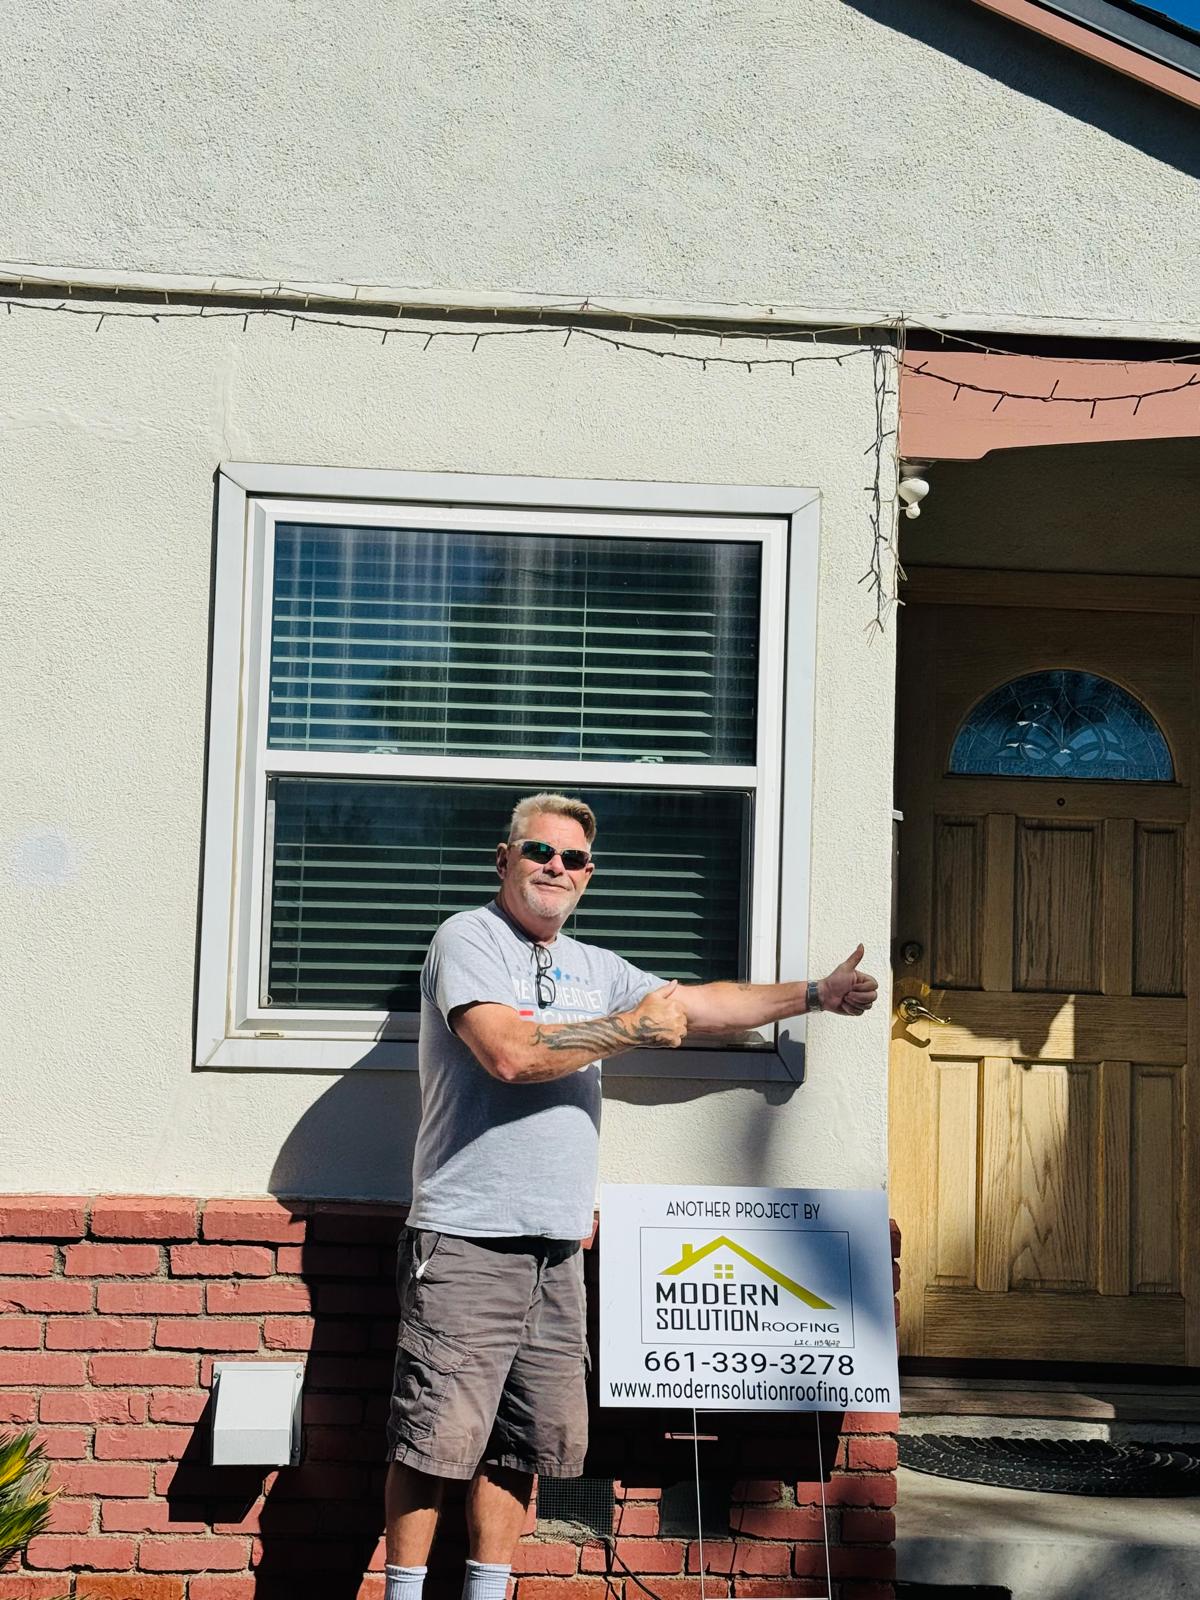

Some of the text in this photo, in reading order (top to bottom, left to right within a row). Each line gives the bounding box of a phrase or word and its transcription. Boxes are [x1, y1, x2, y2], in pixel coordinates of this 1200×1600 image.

[666, 1200, 820, 1220] ANOTHER PROJECT BY
[655, 1282, 779, 1307] MODERN
[656, 1308, 840, 1334] SOLUTION ROOFING
[644, 1350, 855, 1376] 661-339-3278
[609, 1377, 891, 1408] www.modernsolutionroofing.com
